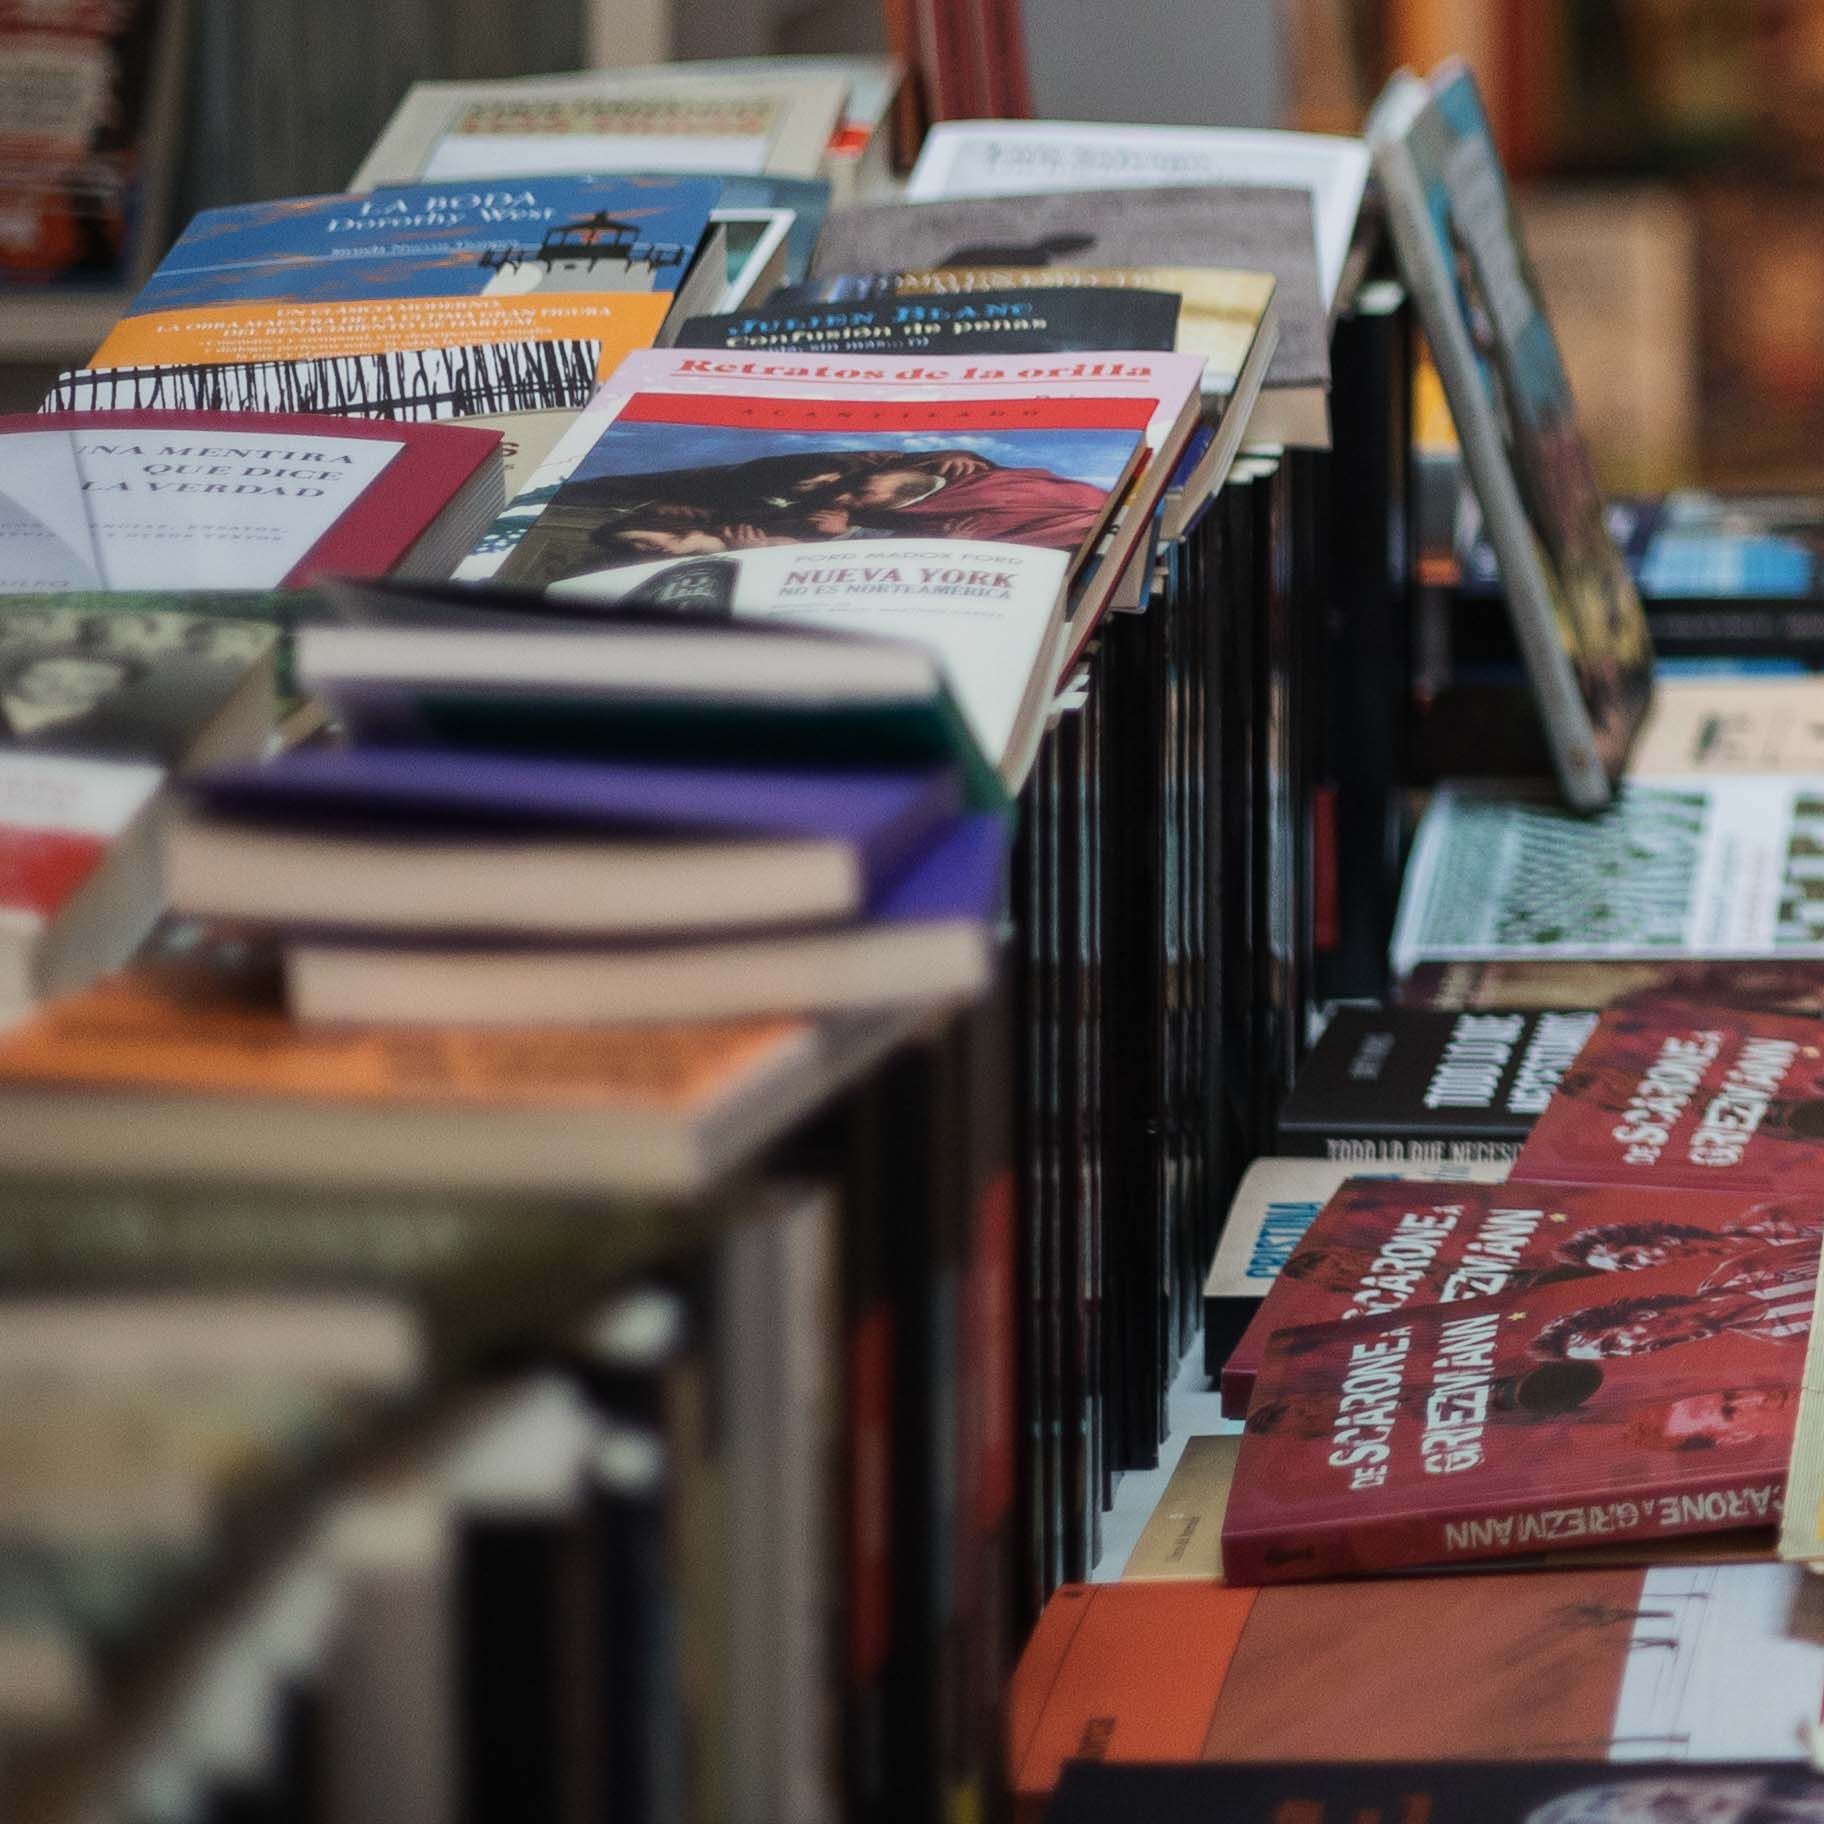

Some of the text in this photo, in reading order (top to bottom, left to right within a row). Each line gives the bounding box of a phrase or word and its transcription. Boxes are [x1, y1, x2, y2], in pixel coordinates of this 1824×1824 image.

[361, 190, 536, 217] LA BODA
[726, 315, 1048, 348] Confusión de penas
[727, 301, 1034, 337] JULIEN BLANC
[679, 359, 1153, 381] Retratos de la orilla
[740, 407, 1042, 420] ACANTILADO
[158, 446, 354, 465] MENTIRA
[142, 463, 344, 482] QUE DICE
[81, 480, 326, 499] LA VERDAD
[795, 551, 1025, 565] FORD MADOX FORD
[784, 567, 1019, 589] NUEVA YORK
[777, 582, 1013, 601] NO ES NORTEAMÉRICA
[1612, 1035, 1710, 1158] SCARONE
[1688, 1037, 1800, 1167] GRIEZMANN
[1327, 1139, 1377, 1161] TODO
[1380, 1140, 1405, 1161] LO
[1449, 1141, 1522, 1162] NECESI
[1622, 1145, 1662, 1166] DE
[1345, 1212, 1455, 1319] CARONE
[1439, 1209, 1544, 1303] EZMANN
[1329, 1341, 1406, 1468] SCARONE
[1421, 1312, 1500, 1475] GRIEZMANN
[1349, 1464, 1388, 1490] DE
[1658, 1484, 1784, 1526] ARONE
[1445, 1499, 1641, 1552] GRIEZMANN
